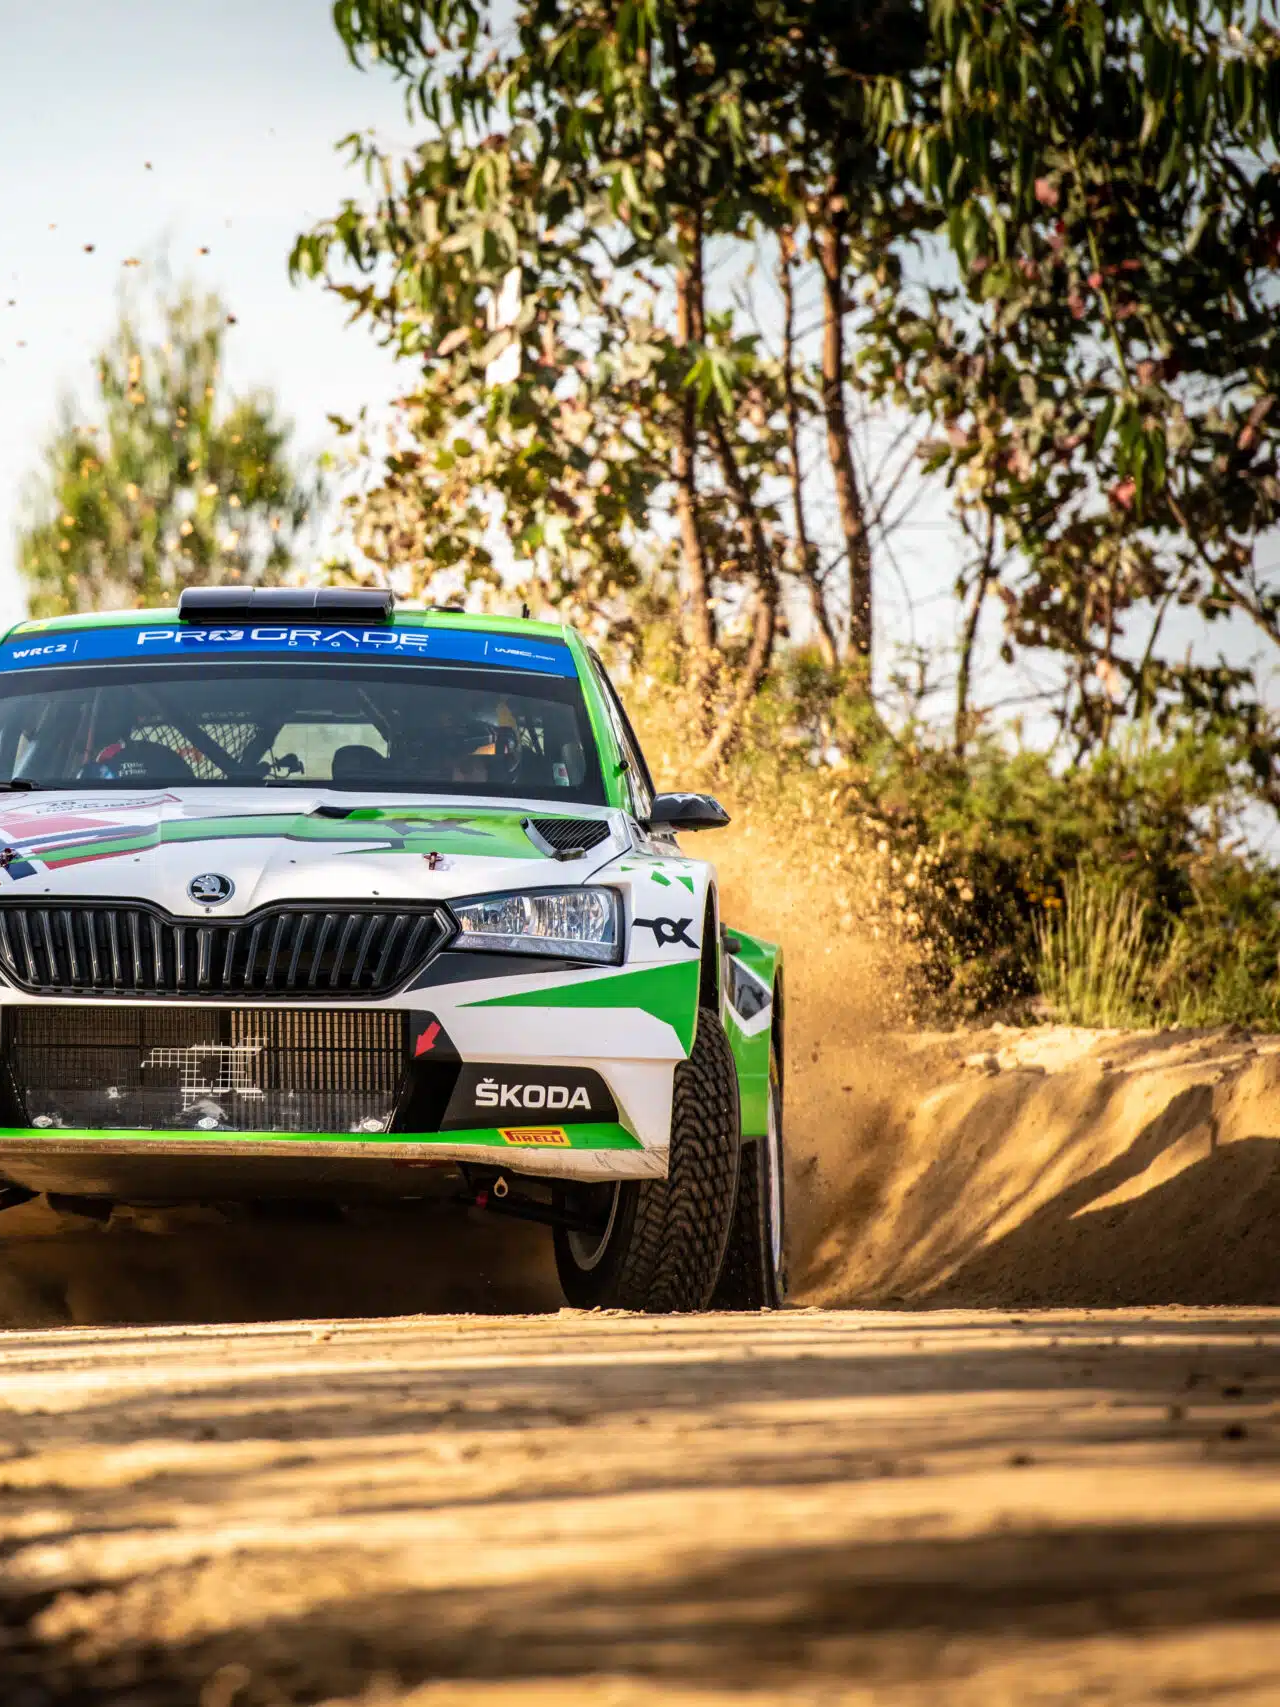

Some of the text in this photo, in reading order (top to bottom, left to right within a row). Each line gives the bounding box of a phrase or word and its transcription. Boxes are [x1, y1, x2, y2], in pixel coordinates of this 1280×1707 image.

[12, 643, 68, 659] WRC2
[288, 640, 426, 652] DIGITAL
[475, 1078, 592, 1109] ŠKODA
[503, 1129, 565, 1143] PIRELLI
